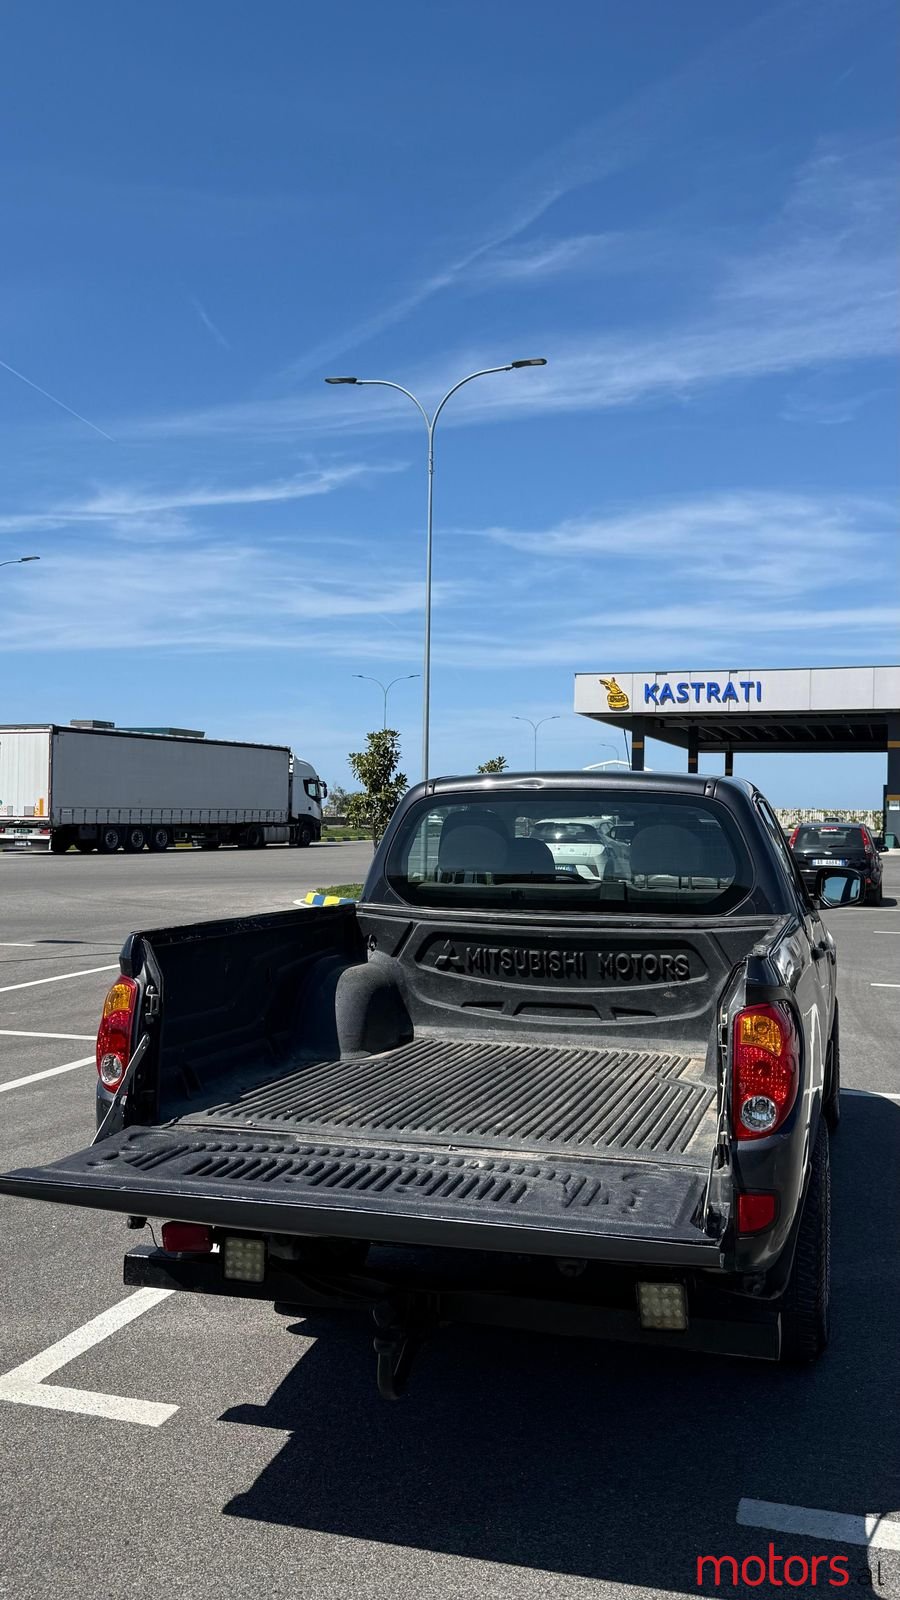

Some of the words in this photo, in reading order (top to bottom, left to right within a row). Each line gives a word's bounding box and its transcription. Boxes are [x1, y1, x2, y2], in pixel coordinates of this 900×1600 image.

[644, 681, 762, 705] KASTRATI
[465, 947, 586, 976] MITSUBISHI
[597, 953, 691, 978] MOTORS
